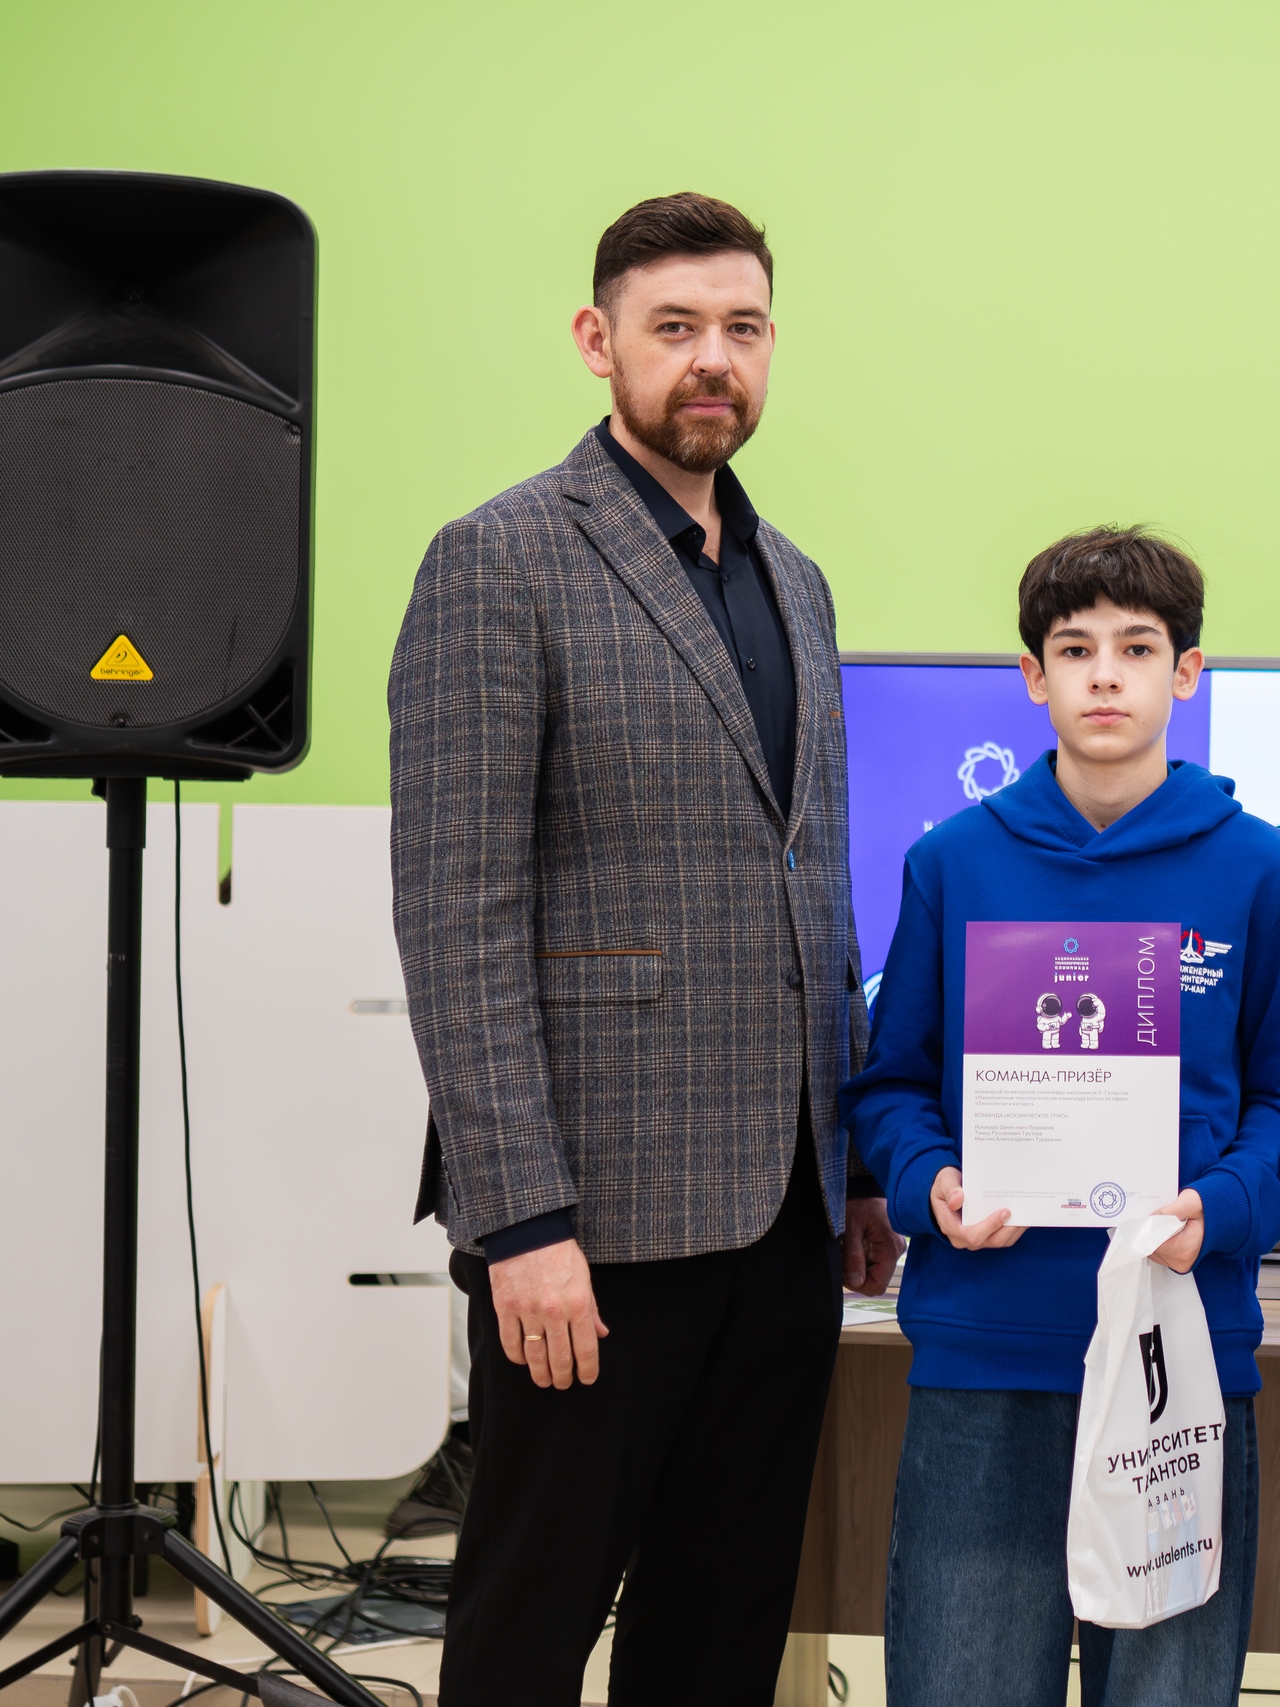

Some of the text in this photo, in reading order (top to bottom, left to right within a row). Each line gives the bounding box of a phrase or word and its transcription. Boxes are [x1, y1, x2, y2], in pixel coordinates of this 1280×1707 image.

[100, 668, 144, 678] behringer
[1054, 972, 1089, 983] junior
[1137, 937, 1157, 1046] ДИПЛОМ
[975, 1068, 1112, 1084] КОМАНДА-ПРИЗЁР
